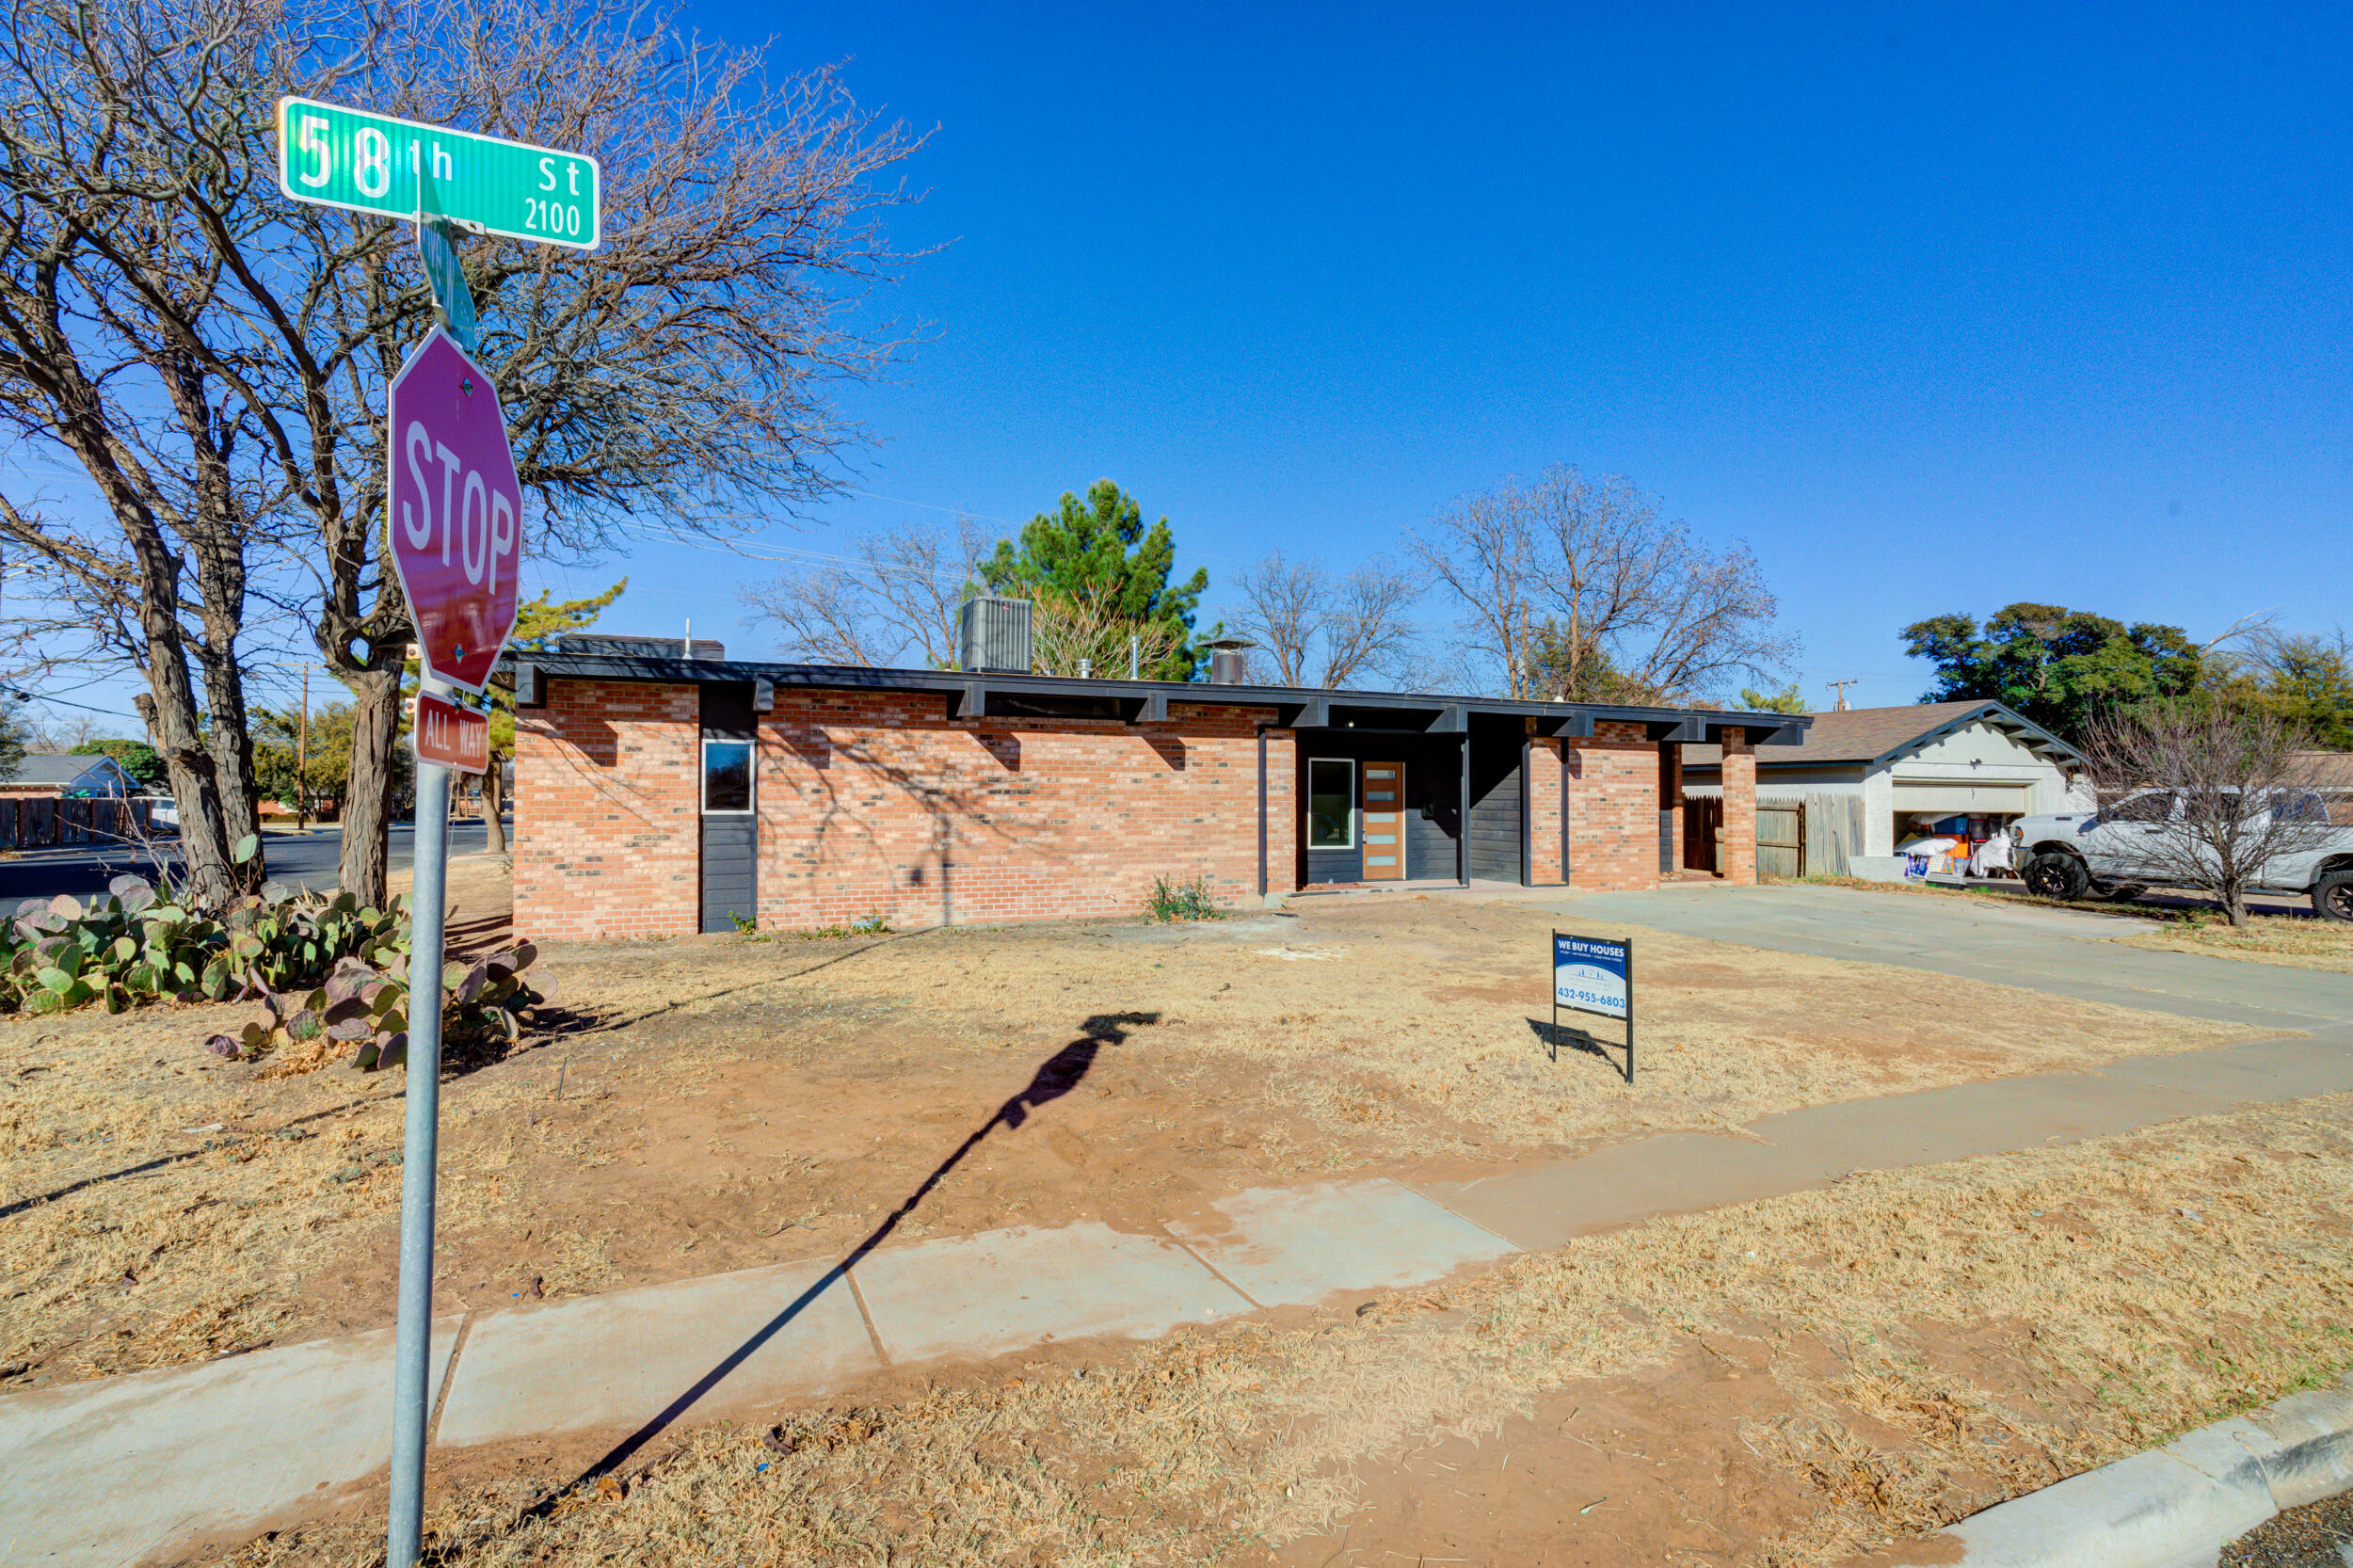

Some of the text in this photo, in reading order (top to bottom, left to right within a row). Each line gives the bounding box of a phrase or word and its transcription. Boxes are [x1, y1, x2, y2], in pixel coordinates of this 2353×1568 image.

[299, 114, 580, 198] 58th St
[525, 198, 581, 236] 2100
[403, 421, 515, 596] STOP
[424, 709, 483, 758] ALL WAY
[1559, 940, 1571, 950] WE
[1572, 942, 1589, 952] BUY
[1591, 945, 1625, 957] HOUSES
[1558, 987, 1625, 1008] 432-955-6803
